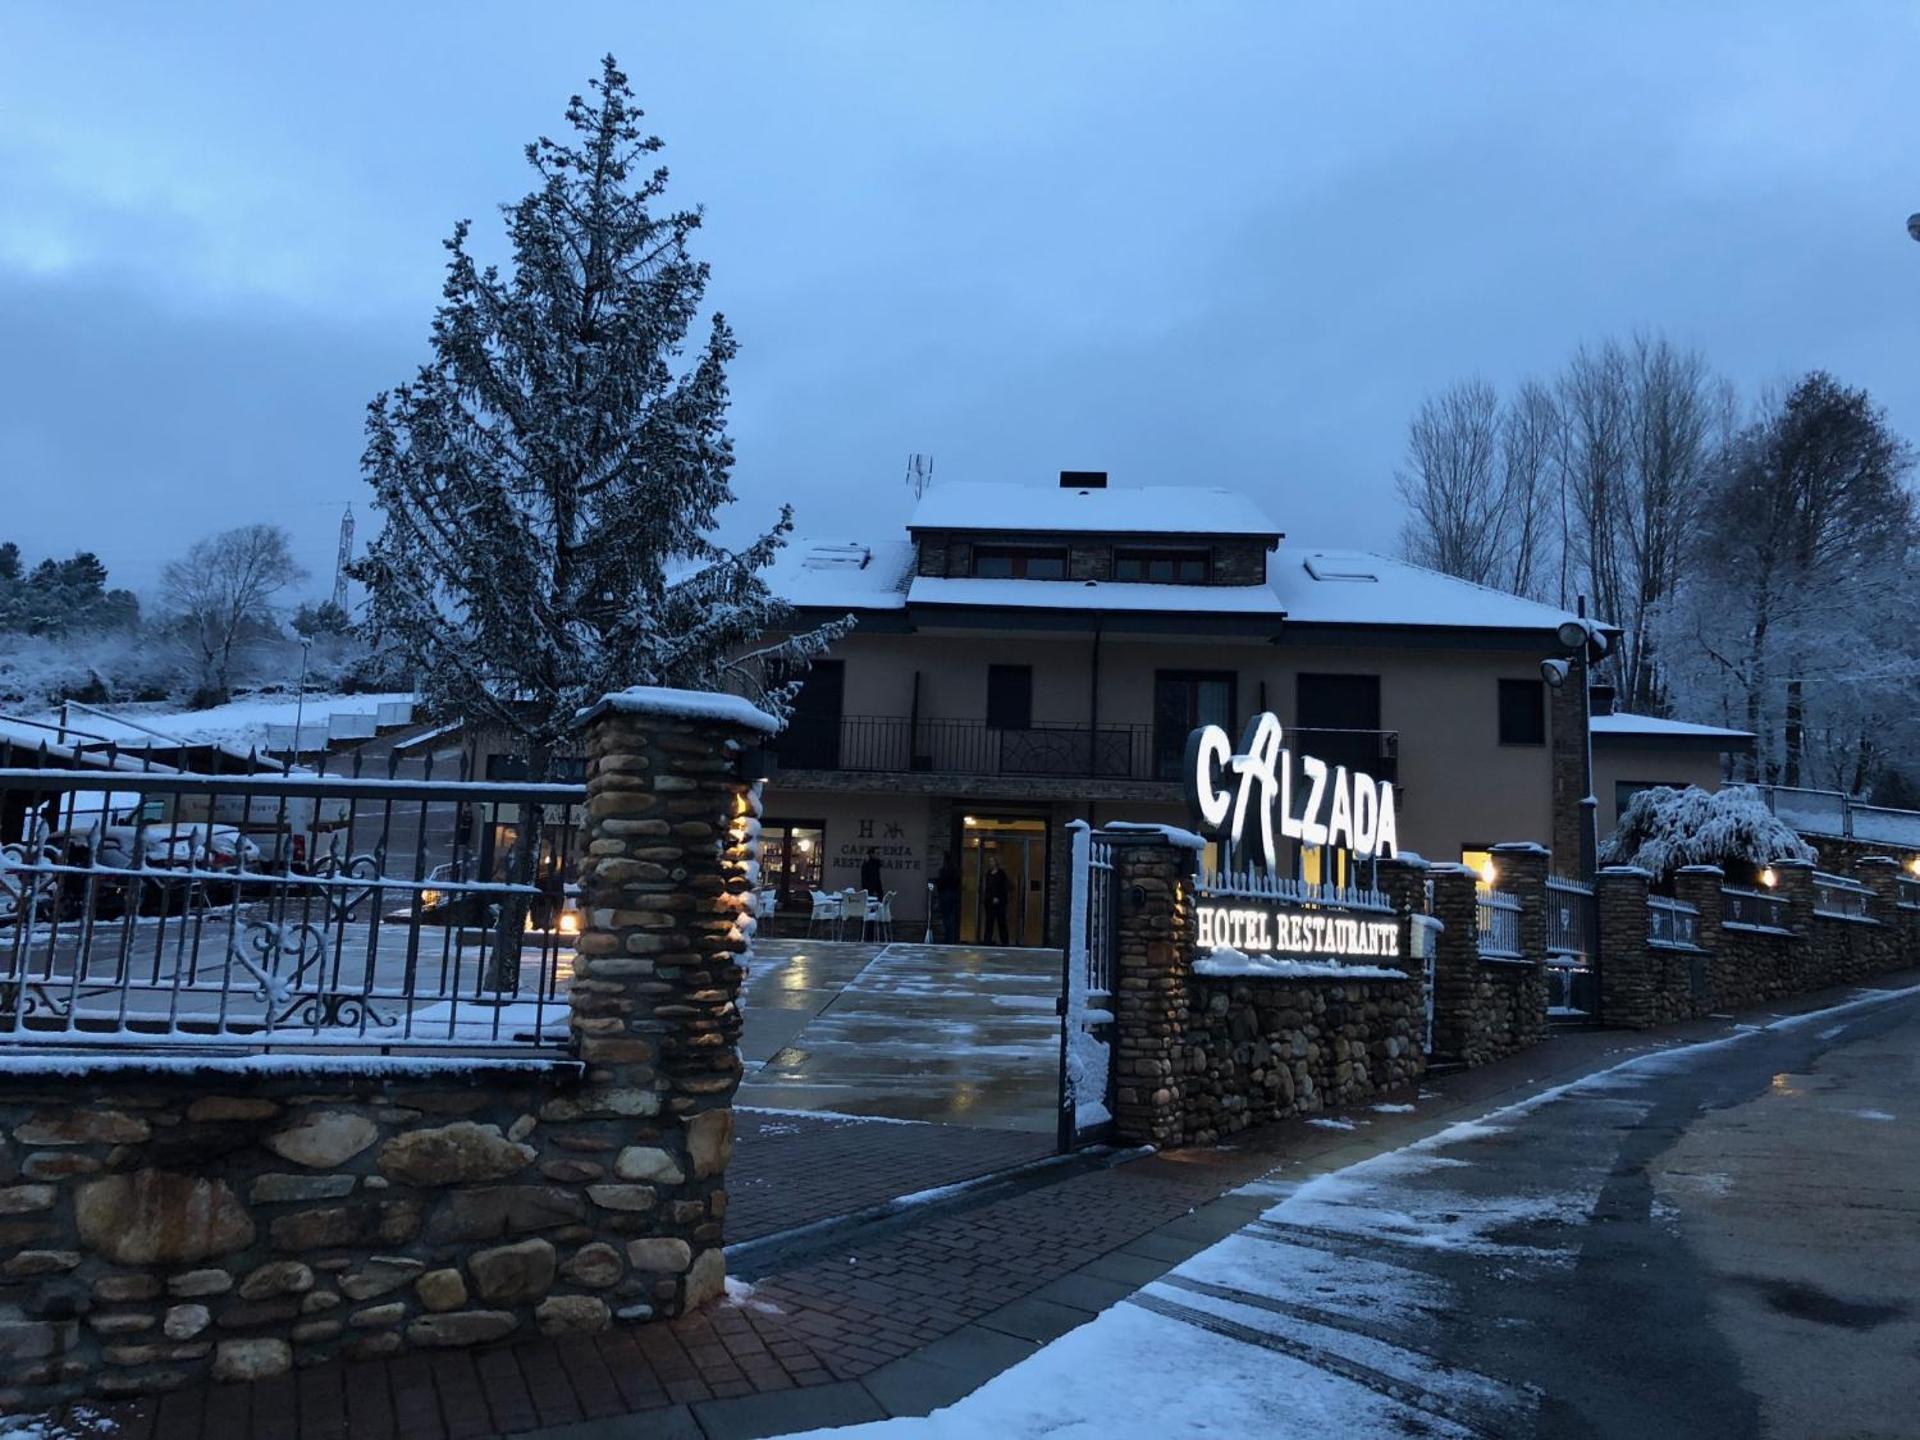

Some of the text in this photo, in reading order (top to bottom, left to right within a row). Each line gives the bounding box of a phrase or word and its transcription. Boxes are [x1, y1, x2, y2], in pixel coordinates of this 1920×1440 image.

[1196, 711, 1398, 876] CALZADA
[857, 819, 874, 838] H
[841, 844, 912, 856] CAFTERIA
[833, 858, 921, 870] RESTRANTE
[1196, 907, 1399, 957] HOTEL RESTAURANTE
